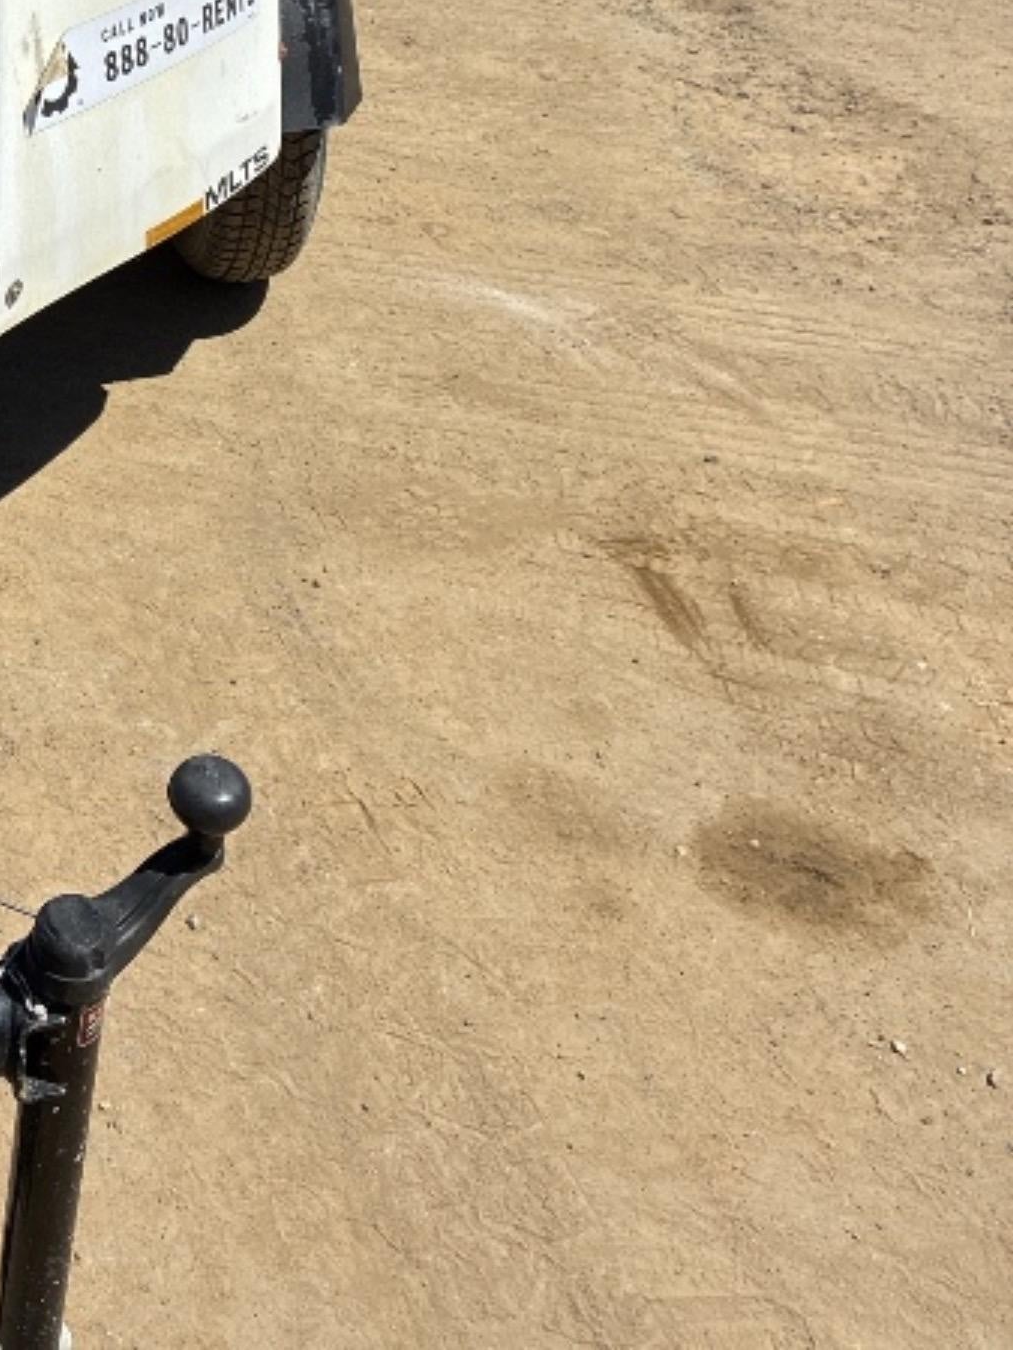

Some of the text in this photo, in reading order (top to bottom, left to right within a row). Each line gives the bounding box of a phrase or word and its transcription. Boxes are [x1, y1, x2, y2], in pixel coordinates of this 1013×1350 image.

[100, 2, 166, 42] CALL NOW
[205, 146, 268, 211] MLTS
